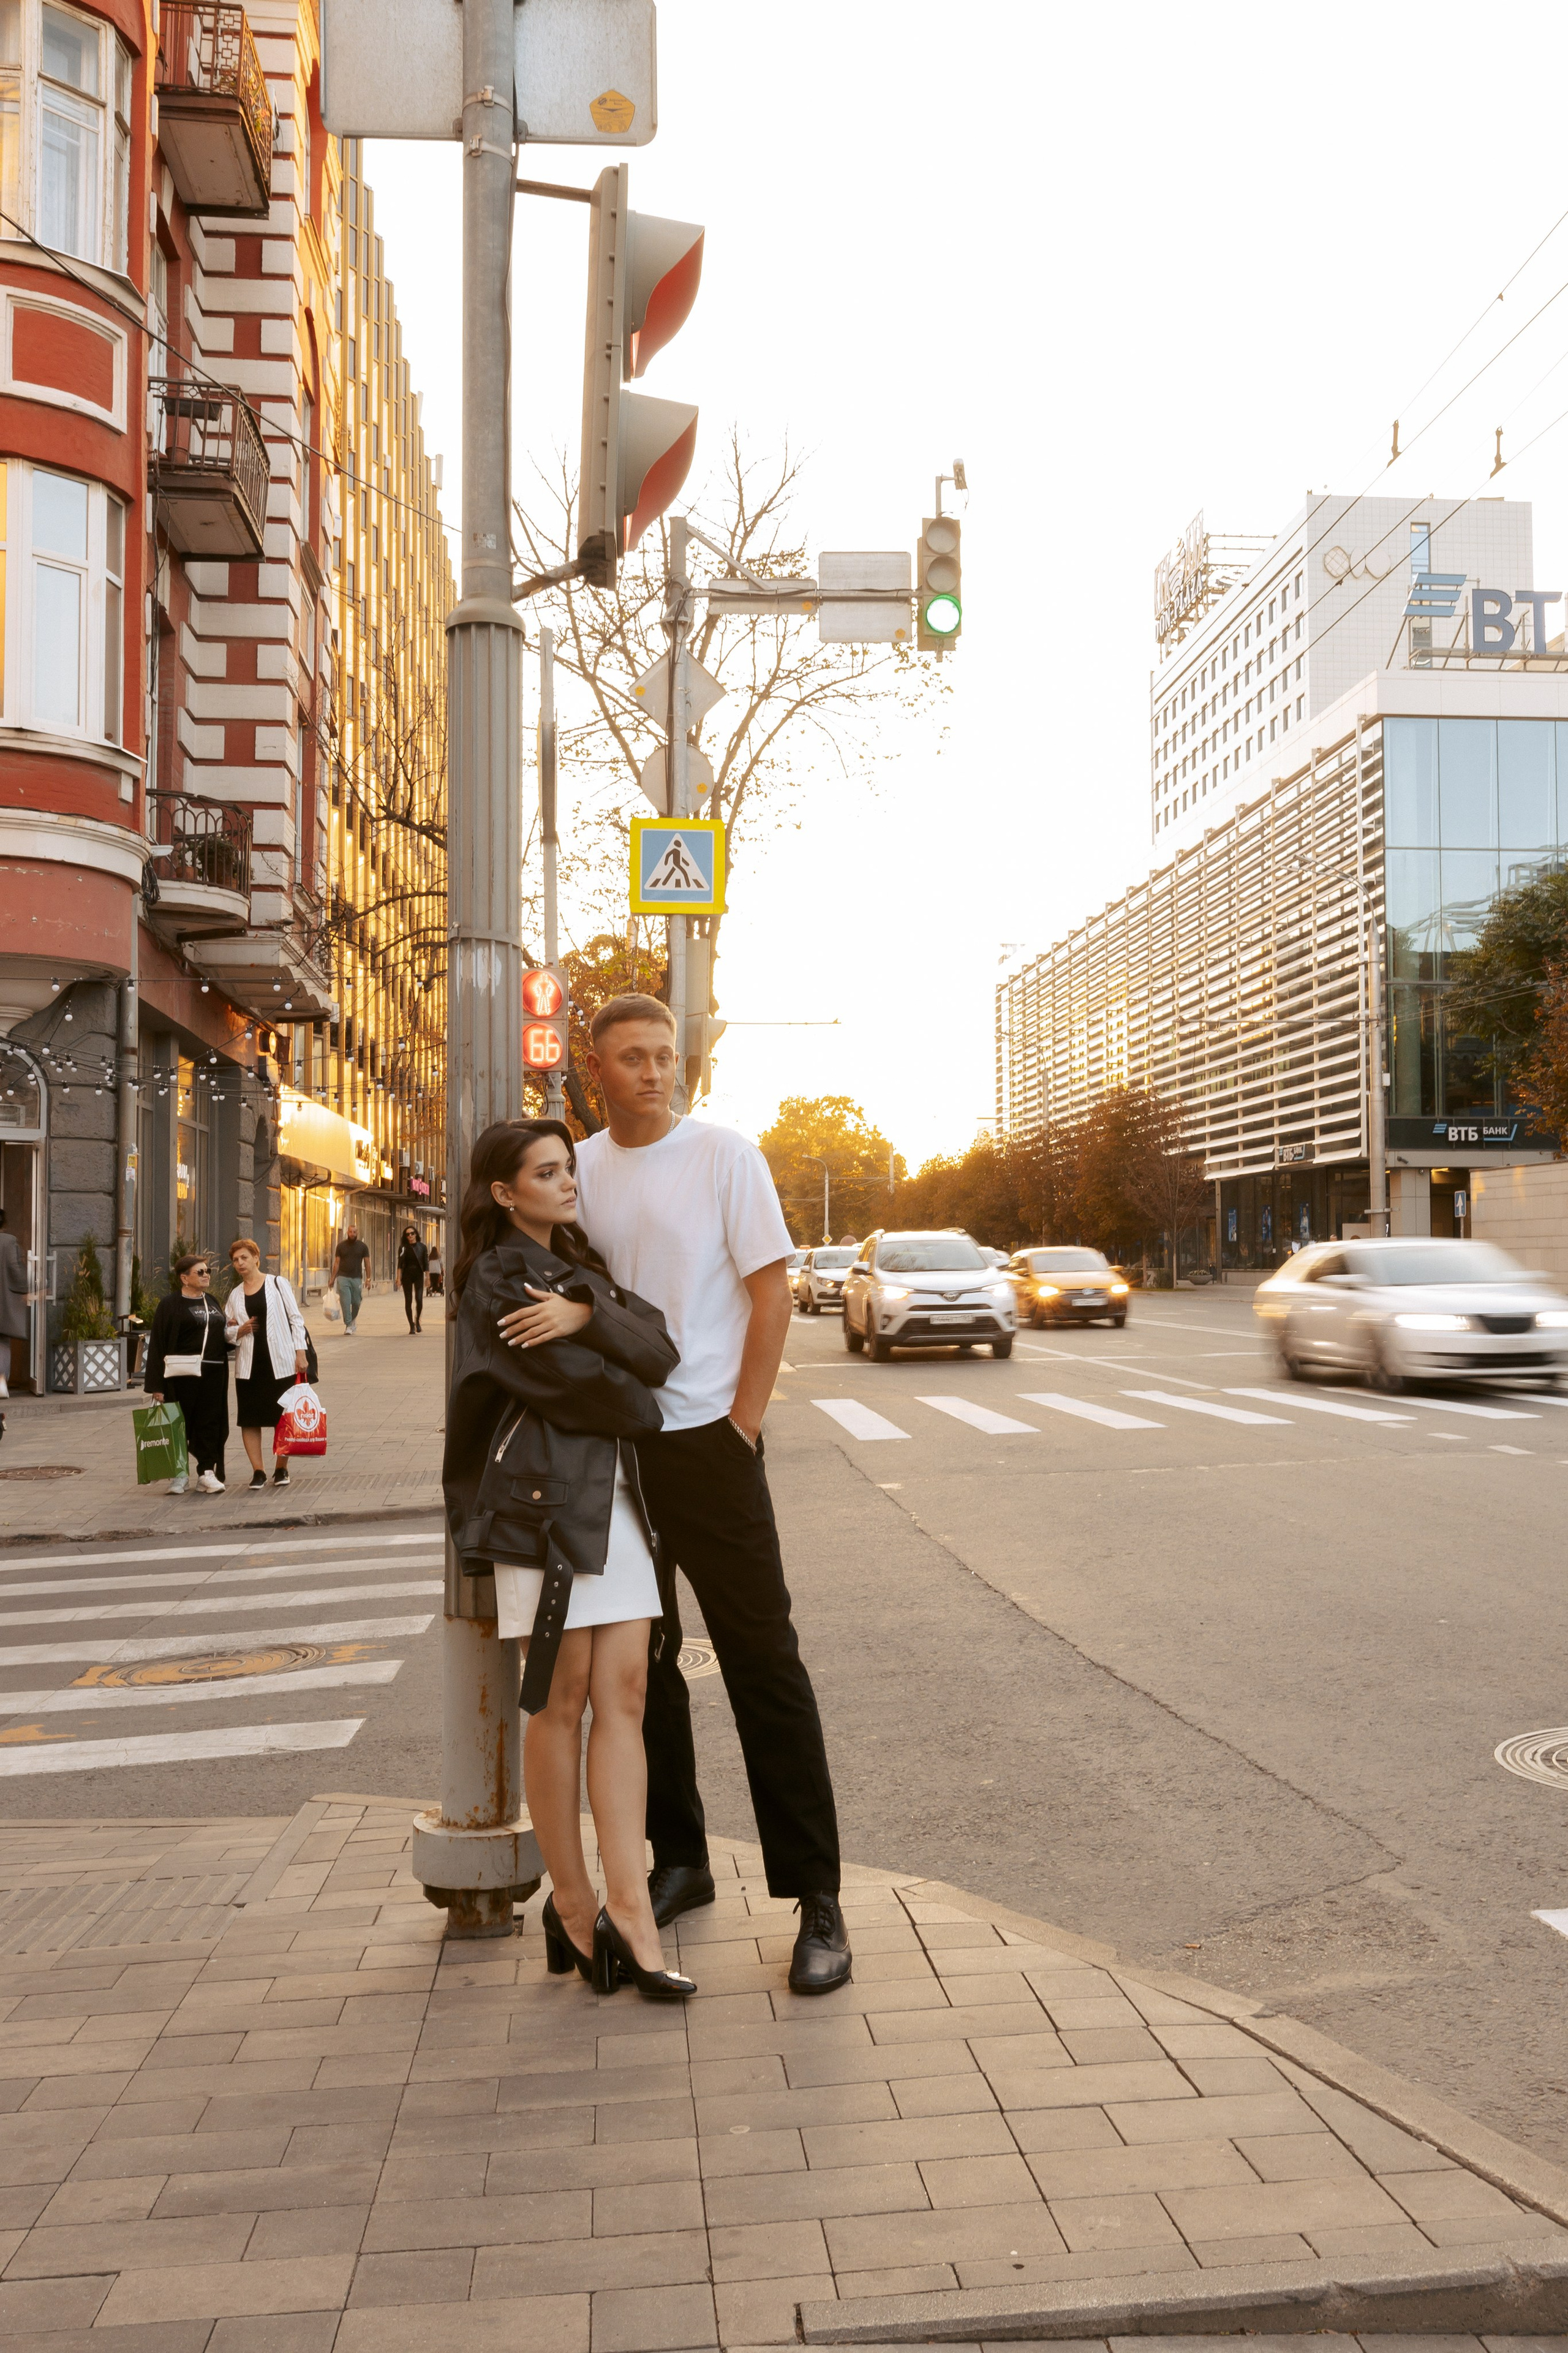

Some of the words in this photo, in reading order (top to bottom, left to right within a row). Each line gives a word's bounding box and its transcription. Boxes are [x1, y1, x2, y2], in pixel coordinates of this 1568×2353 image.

[1471, 589, 1568, 654] ВТ
[530, 1029, 560, 1062] 66
[1449, 1126, 1479, 1141] ВТБ
[1483, 1127, 1508, 1135] БАНК
[143, 1438, 170, 1448] remonte
